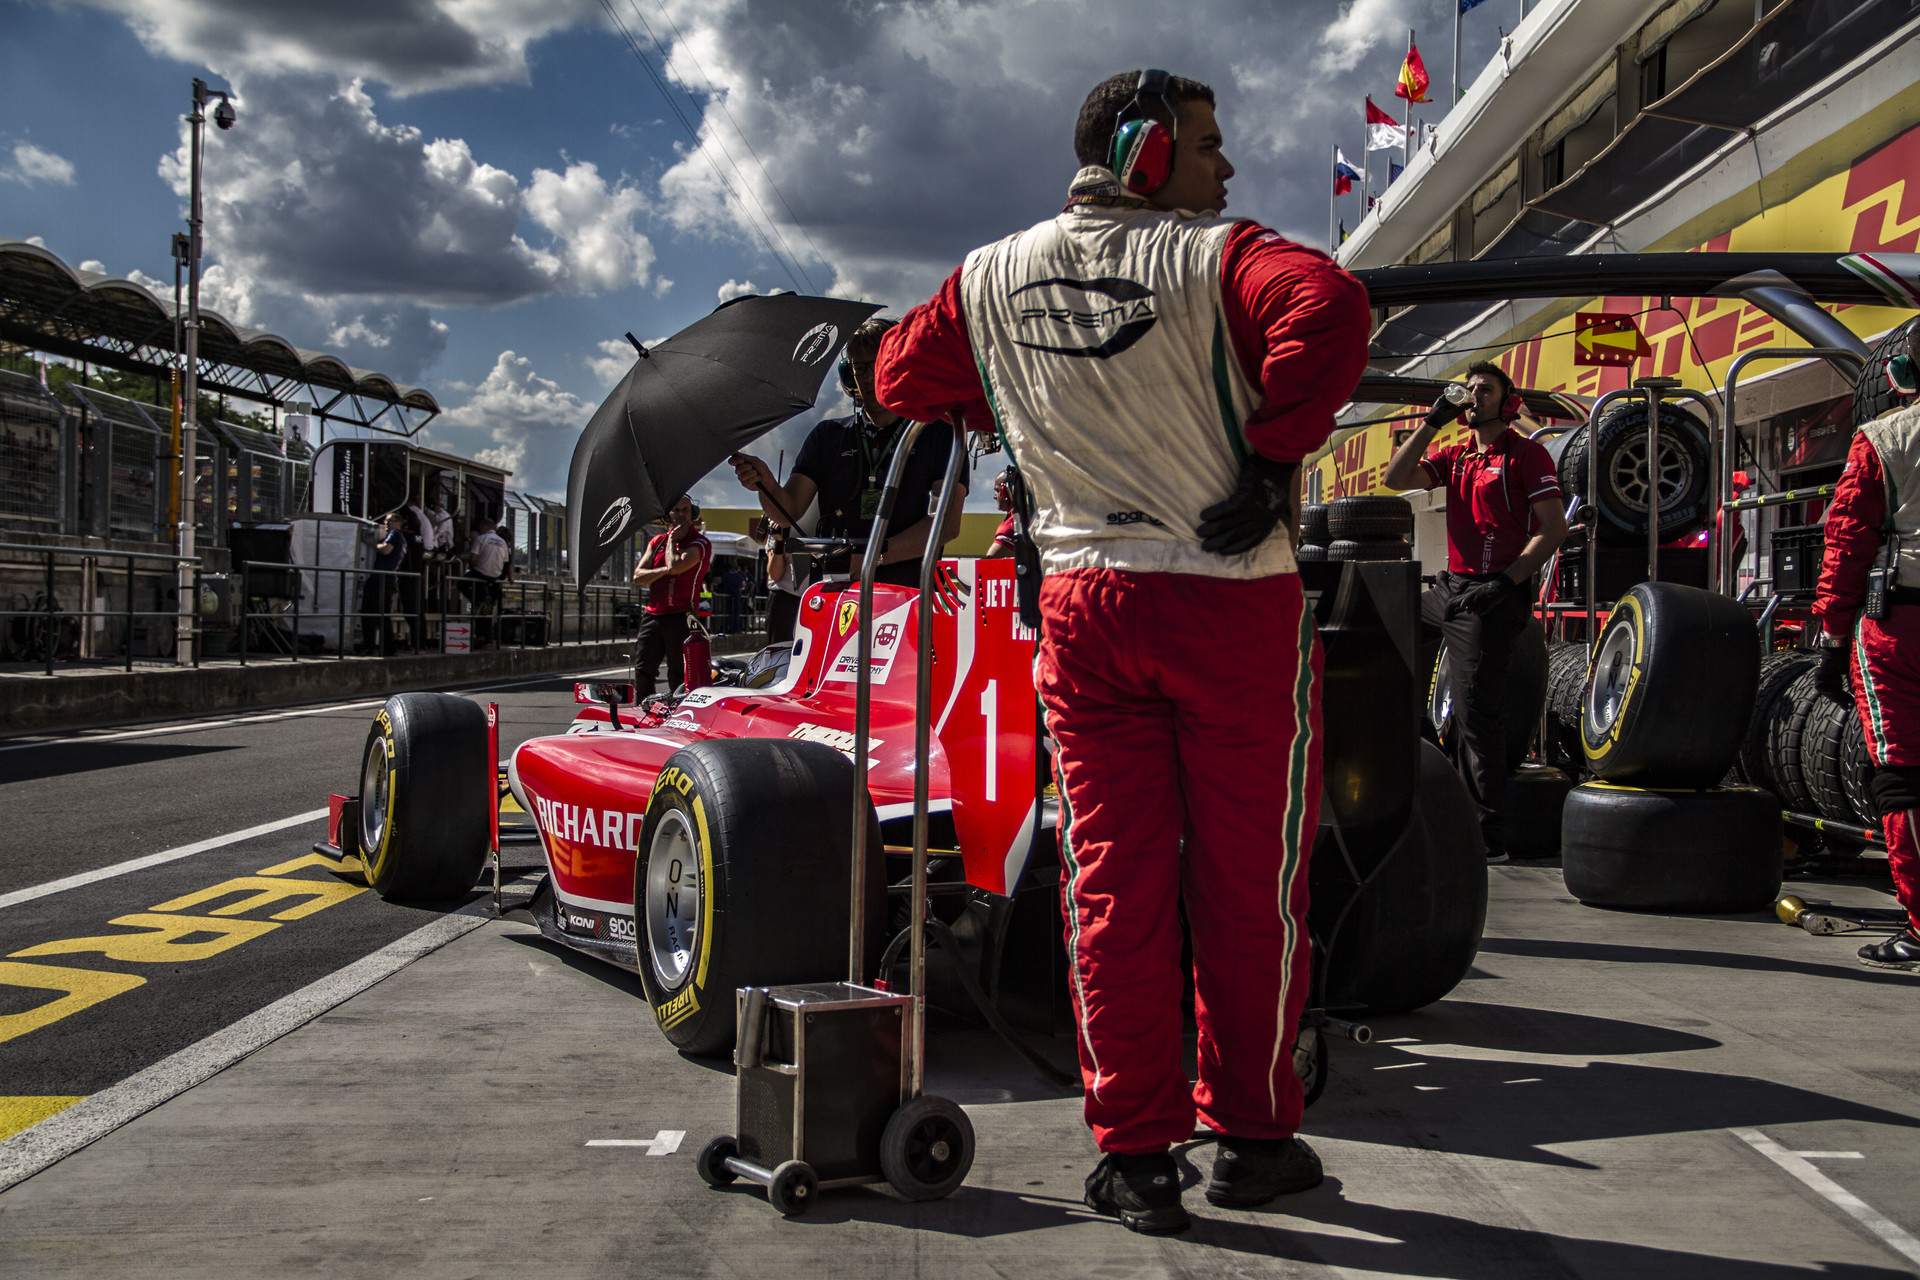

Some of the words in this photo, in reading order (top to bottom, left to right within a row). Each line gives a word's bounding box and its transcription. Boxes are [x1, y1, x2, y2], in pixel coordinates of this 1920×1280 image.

[1020, 301, 1154, 329] PREMA
[800, 324, 834, 363] PREMA
[598, 503, 632, 538] PREMA
[1482, 532, 1496, 575] PREMA
[986, 579, 997, 608] JE
[839, 656, 859, 664] DRIVE
[846, 664, 884, 675] ACEMY
[375, 708, 395, 759] ZERO
[979, 679, 997, 801] 1
[536, 796, 645, 850] RICHARD
[569, 914, 595, 930] KONI
[657, 983, 701, 1032] PIRELLI
